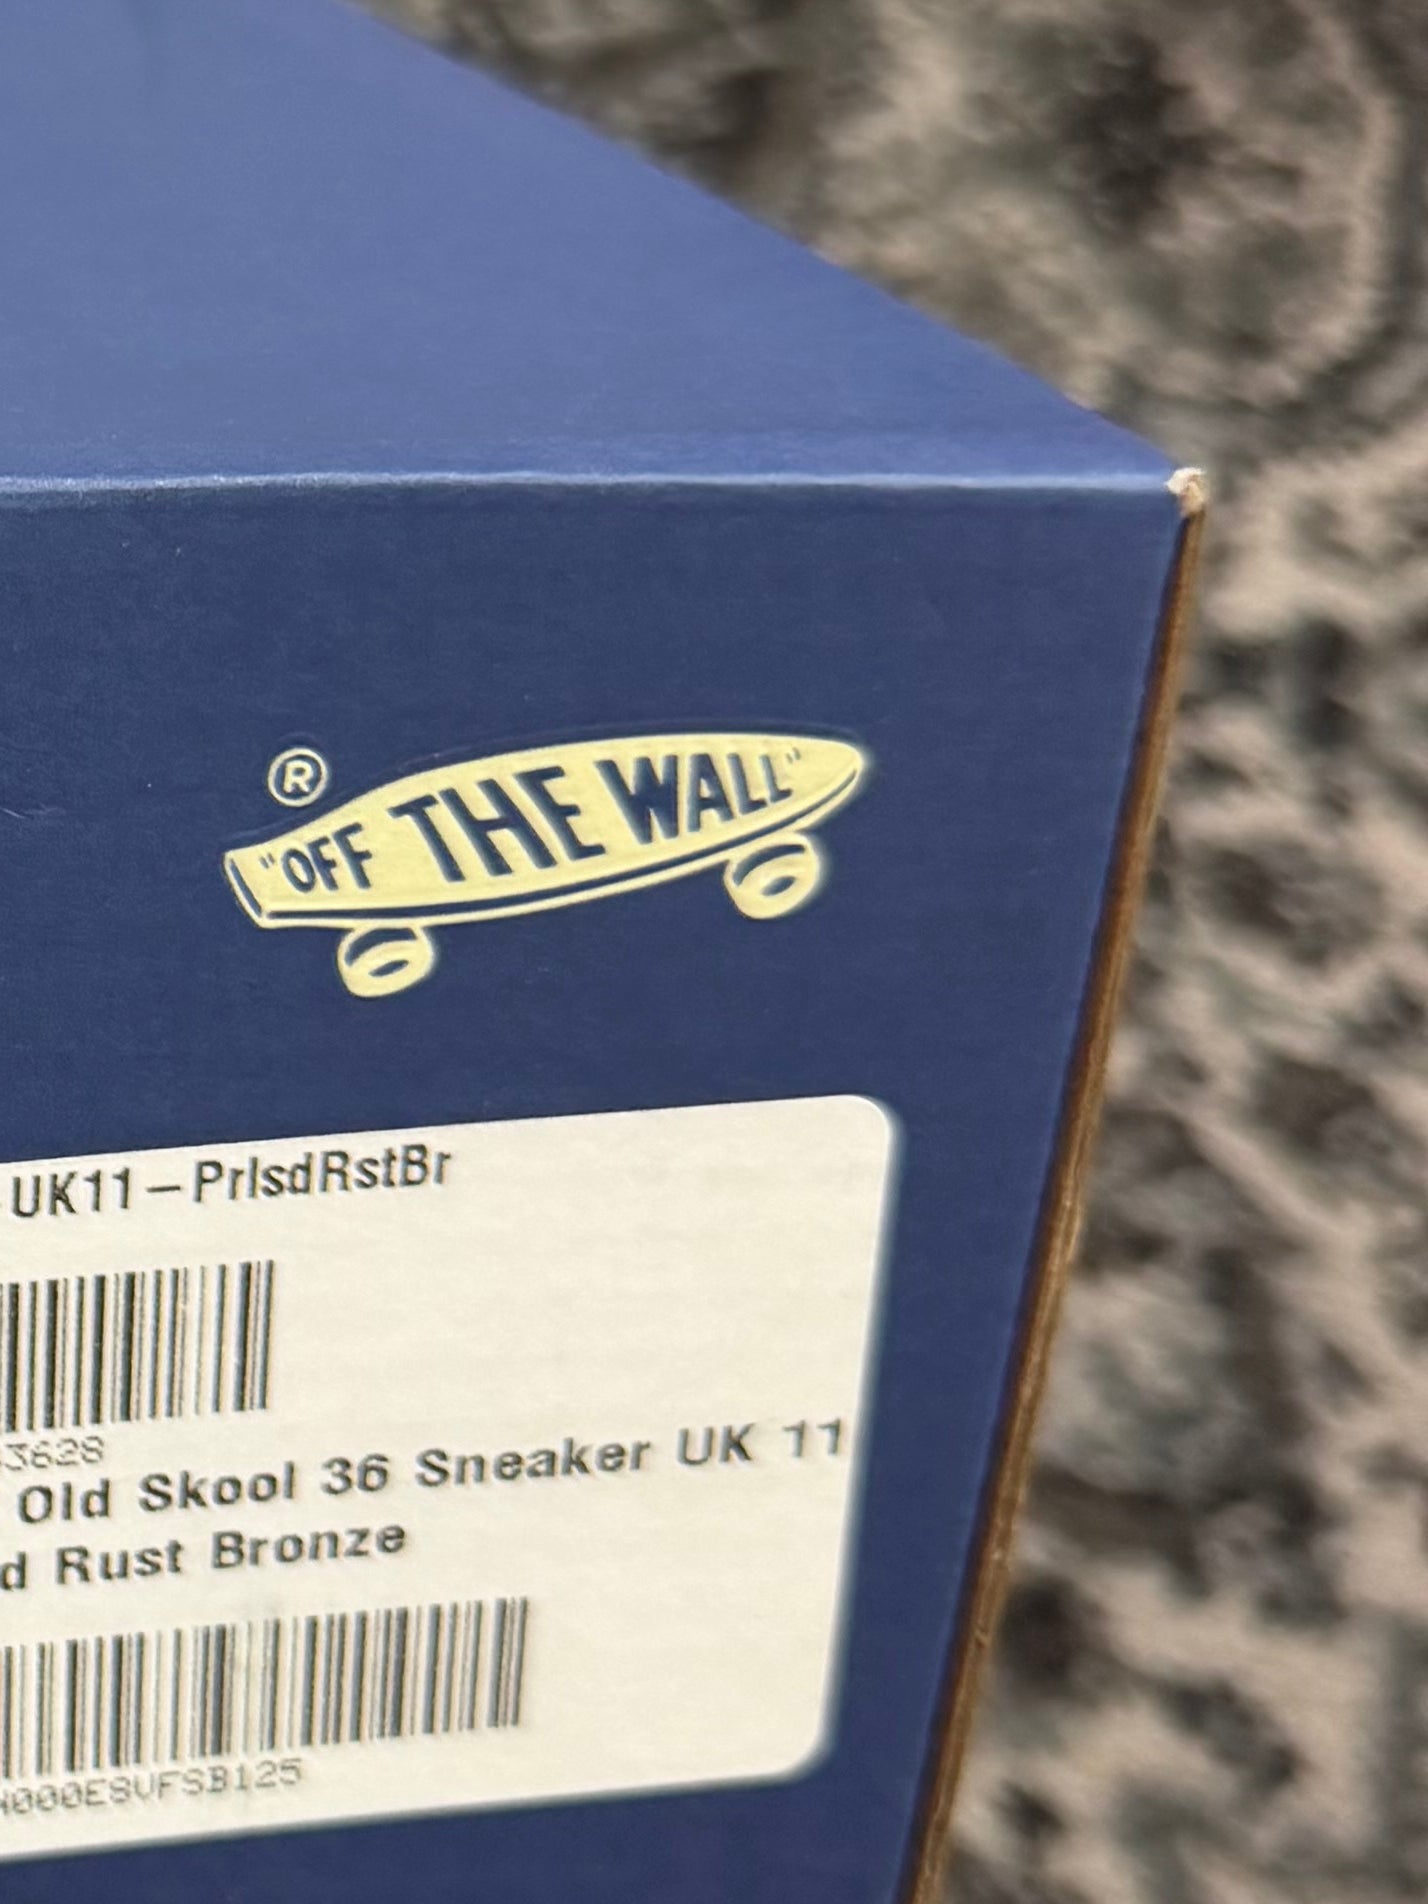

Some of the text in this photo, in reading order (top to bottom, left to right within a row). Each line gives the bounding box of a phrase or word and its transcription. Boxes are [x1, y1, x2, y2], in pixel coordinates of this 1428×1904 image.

[390, 766, 606, 884] THE
[18, 1479, 111, 1524] Old
[142, 1462, 295, 1512] Skool
[321, 1454, 390, 1496] 36
[415, 1439, 651, 1487] Sneaker
[677, 1424, 756, 1467] UK
[784, 1419, 843, 1459] 11
[55, 1541, 184, 1585] Rust
[211, 1523, 406, 1569] Bronze
